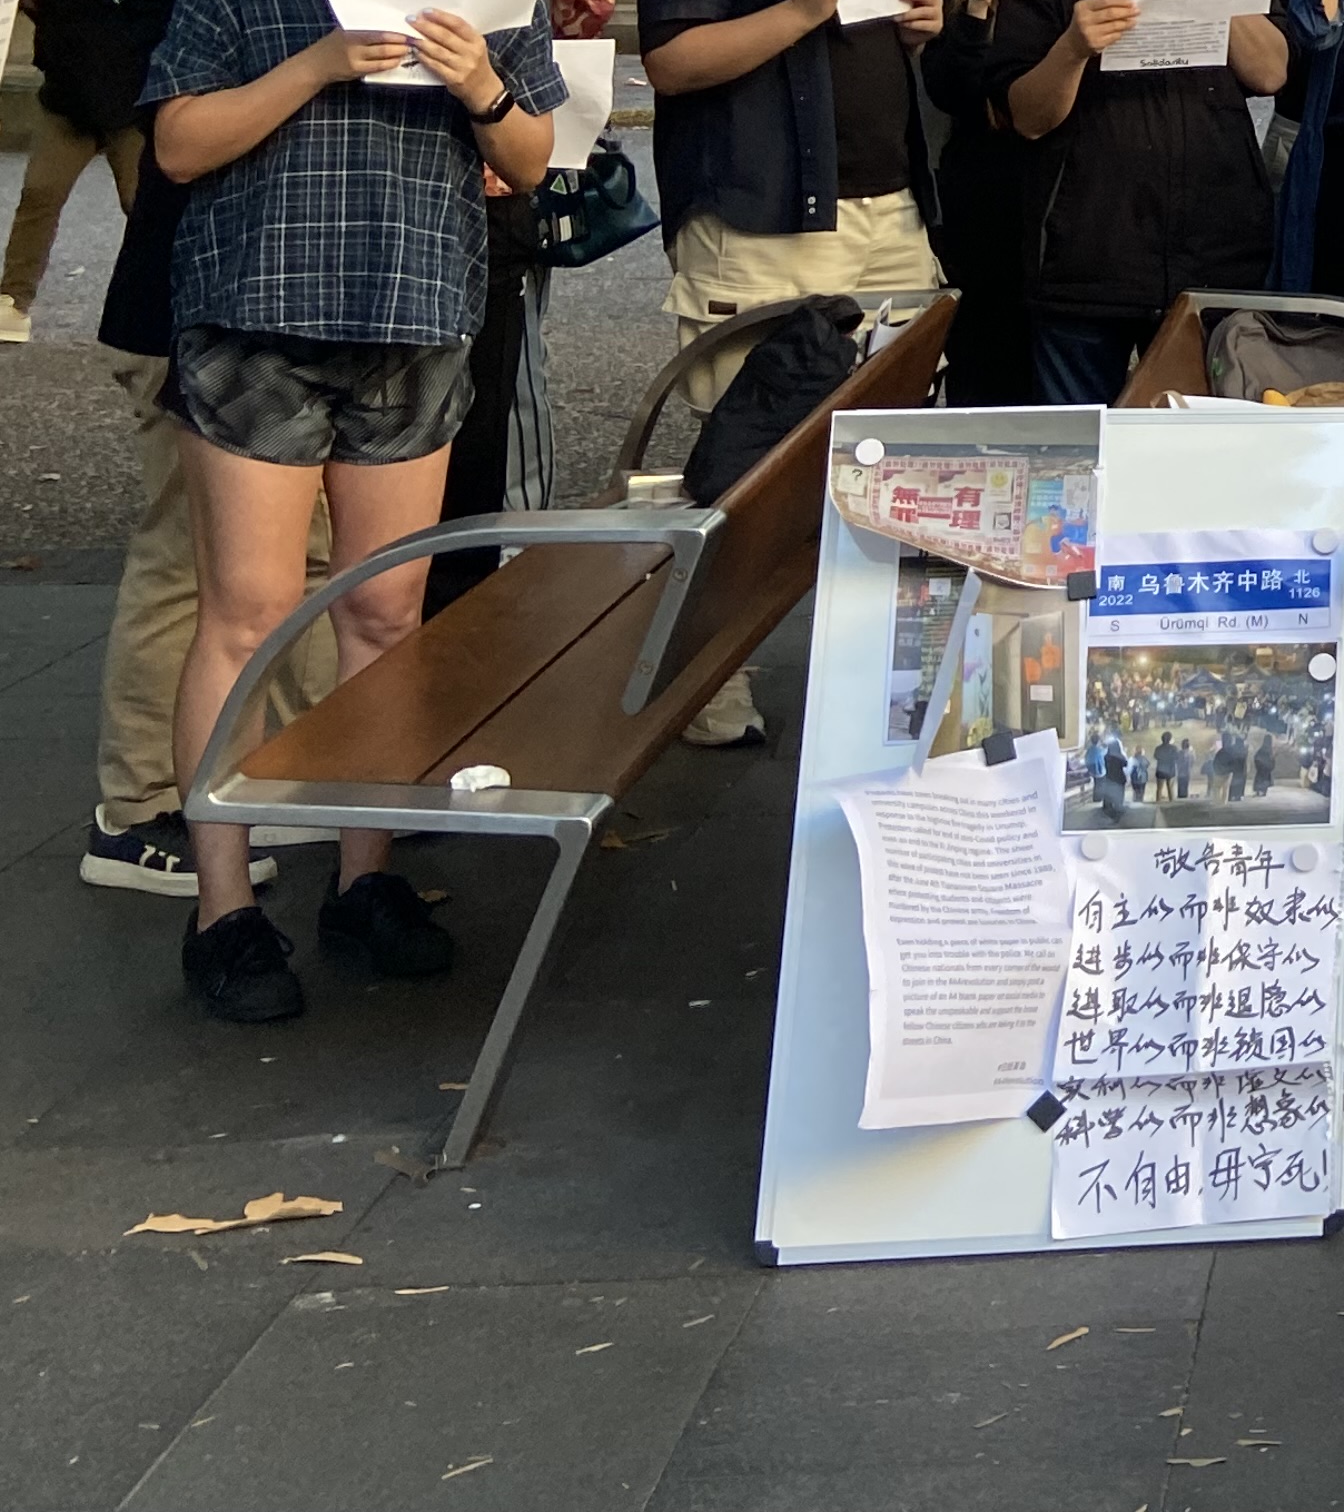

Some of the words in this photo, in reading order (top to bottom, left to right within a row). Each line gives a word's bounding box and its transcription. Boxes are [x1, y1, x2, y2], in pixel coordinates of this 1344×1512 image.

[1107, 575, 1125, 592] 南
[1138, 569, 1283, 595] 乌鲁木齐中路
[1293, 569, 1310, 584] 北
[1098, 594, 1133, 606] 2022
[1289, 587, 1321, 599] 1126
[1110, 620, 1120, 631] S
[1160, 616, 1208, 631] Ürümqi
[1246, 615, 1269, 629] (M)
[1299, 613, 1308, 625] N
